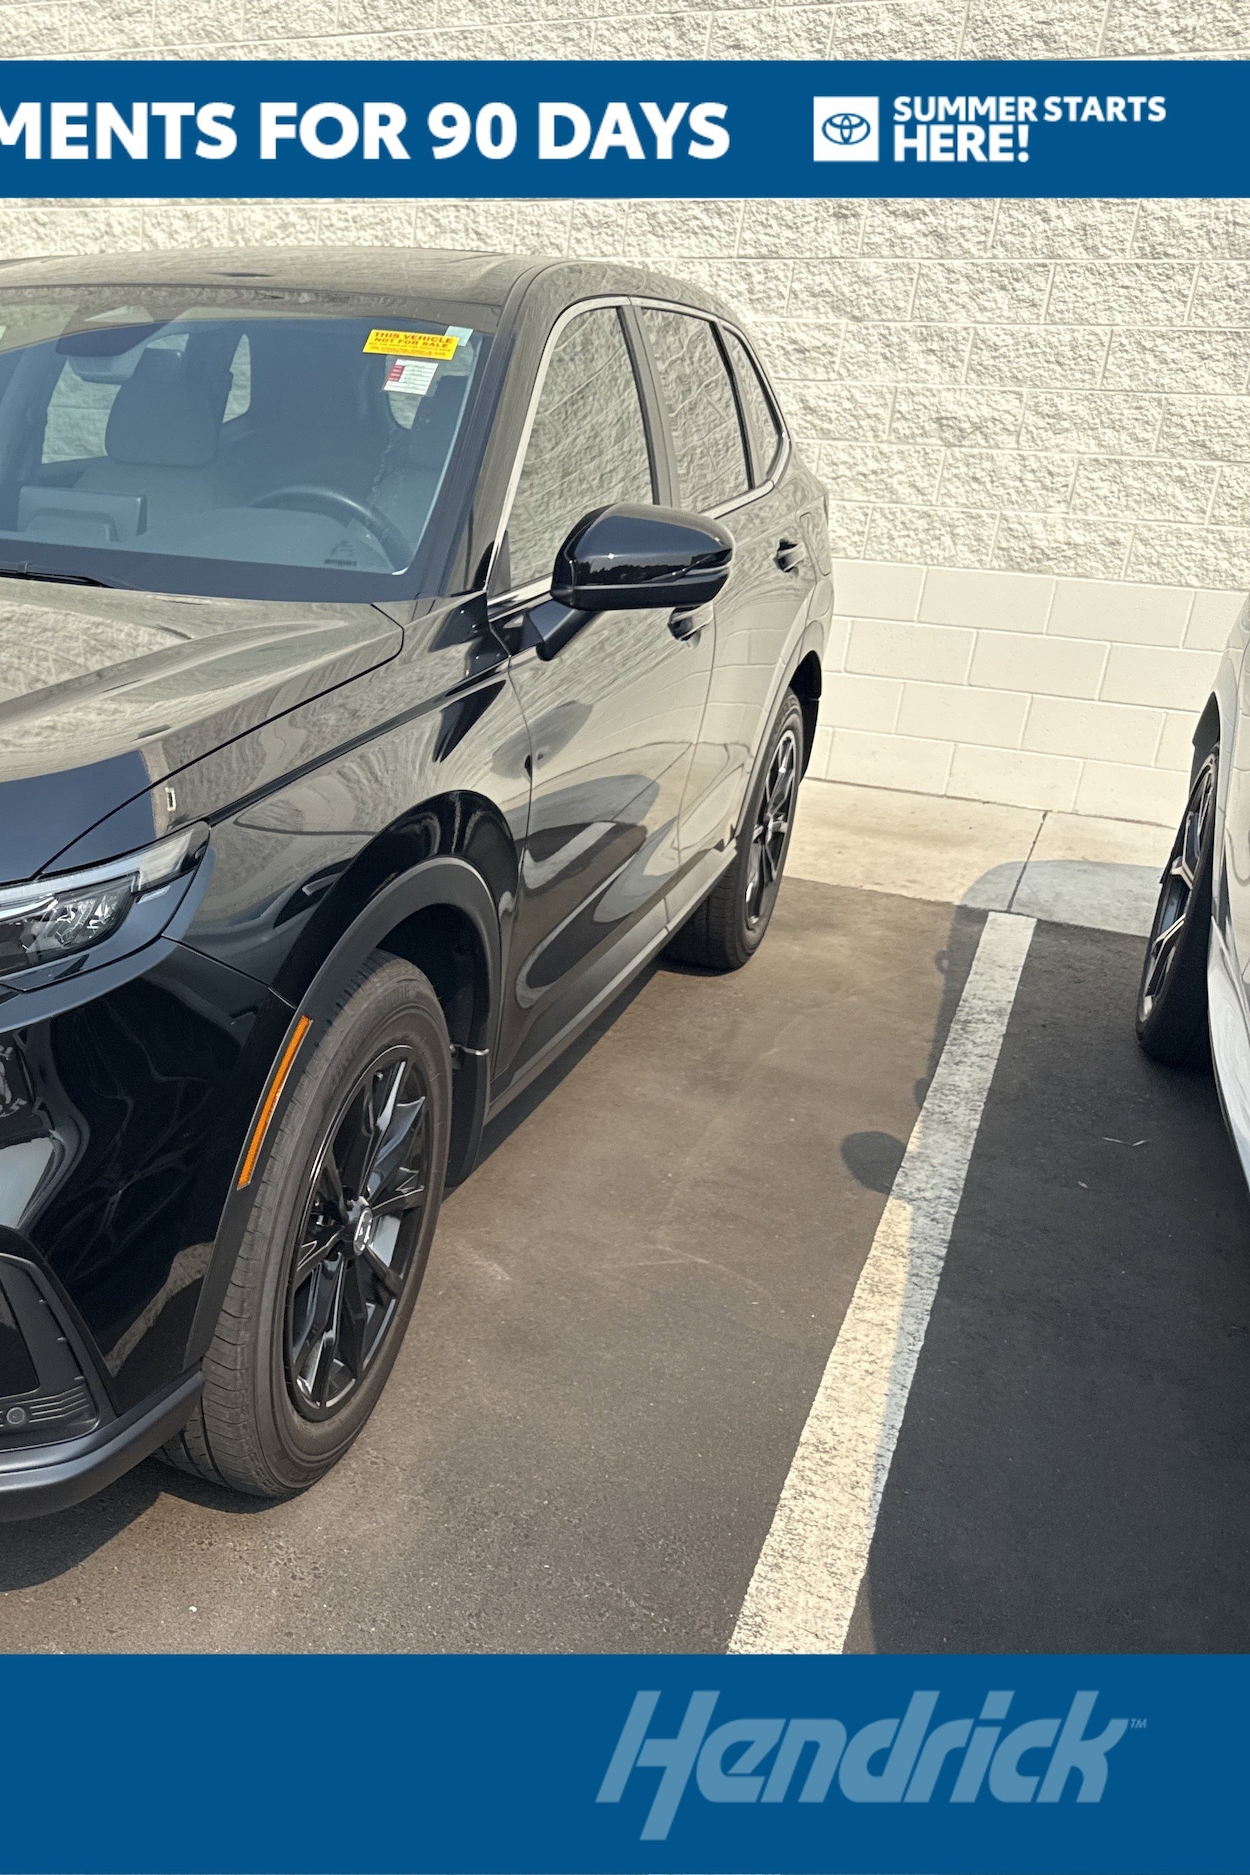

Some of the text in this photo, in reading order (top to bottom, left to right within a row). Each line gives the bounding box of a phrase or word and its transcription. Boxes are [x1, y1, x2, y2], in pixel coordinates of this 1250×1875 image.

[375, 331, 454, 344] THIS VEHICLE
[422, 341, 449, 349] SALE
